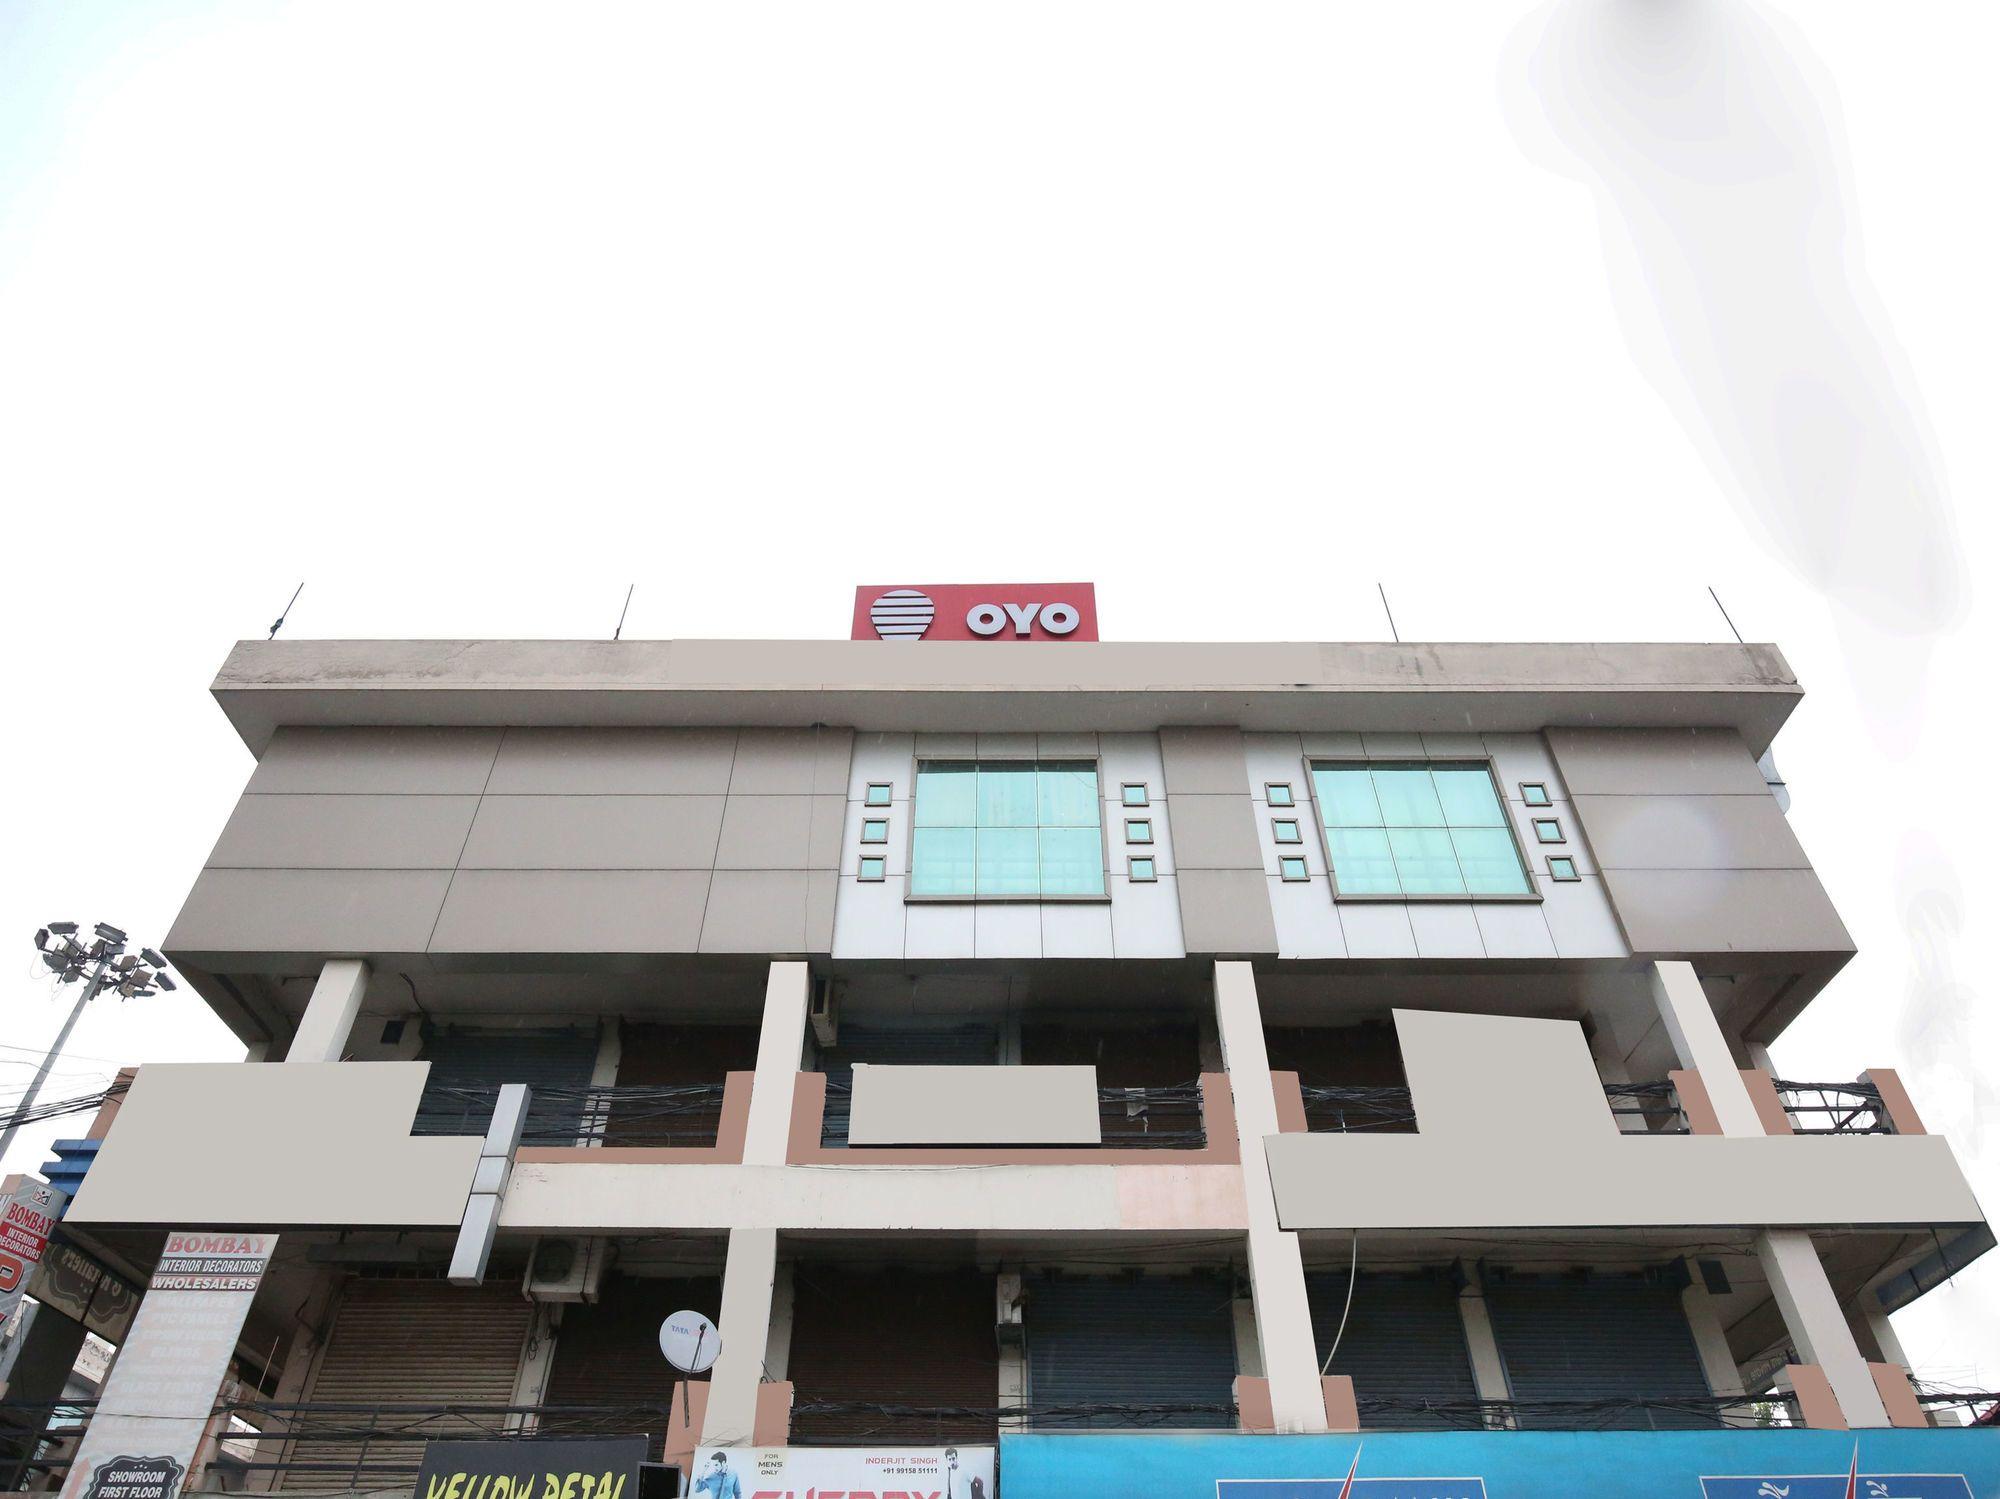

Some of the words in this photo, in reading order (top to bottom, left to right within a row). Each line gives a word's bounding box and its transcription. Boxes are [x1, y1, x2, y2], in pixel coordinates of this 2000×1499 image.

[966, 602, 1079, 638] OYO
[7, 1203, 55, 1235] BOMBAY
[7, 1227, 39, 1248] INTERIOR
[166, 1236, 267, 1254] BOMBAY
[159, 1259, 202, 1272] INTERIOR
[202, 1260, 263, 1273] DECORATORS
[151, 1277, 257, 1290] WHOLESALERS
[672, 1325, 689, 1335] TATA
[865, 1457, 906, 1465] INDERJIT
[910, 1457, 938, 1465] SINGH
[108, 1471, 166, 1483] SHOWROOM
[98, 1486, 128, 1498] FIRST
[129, 1486, 163, 1498] FLOOR
